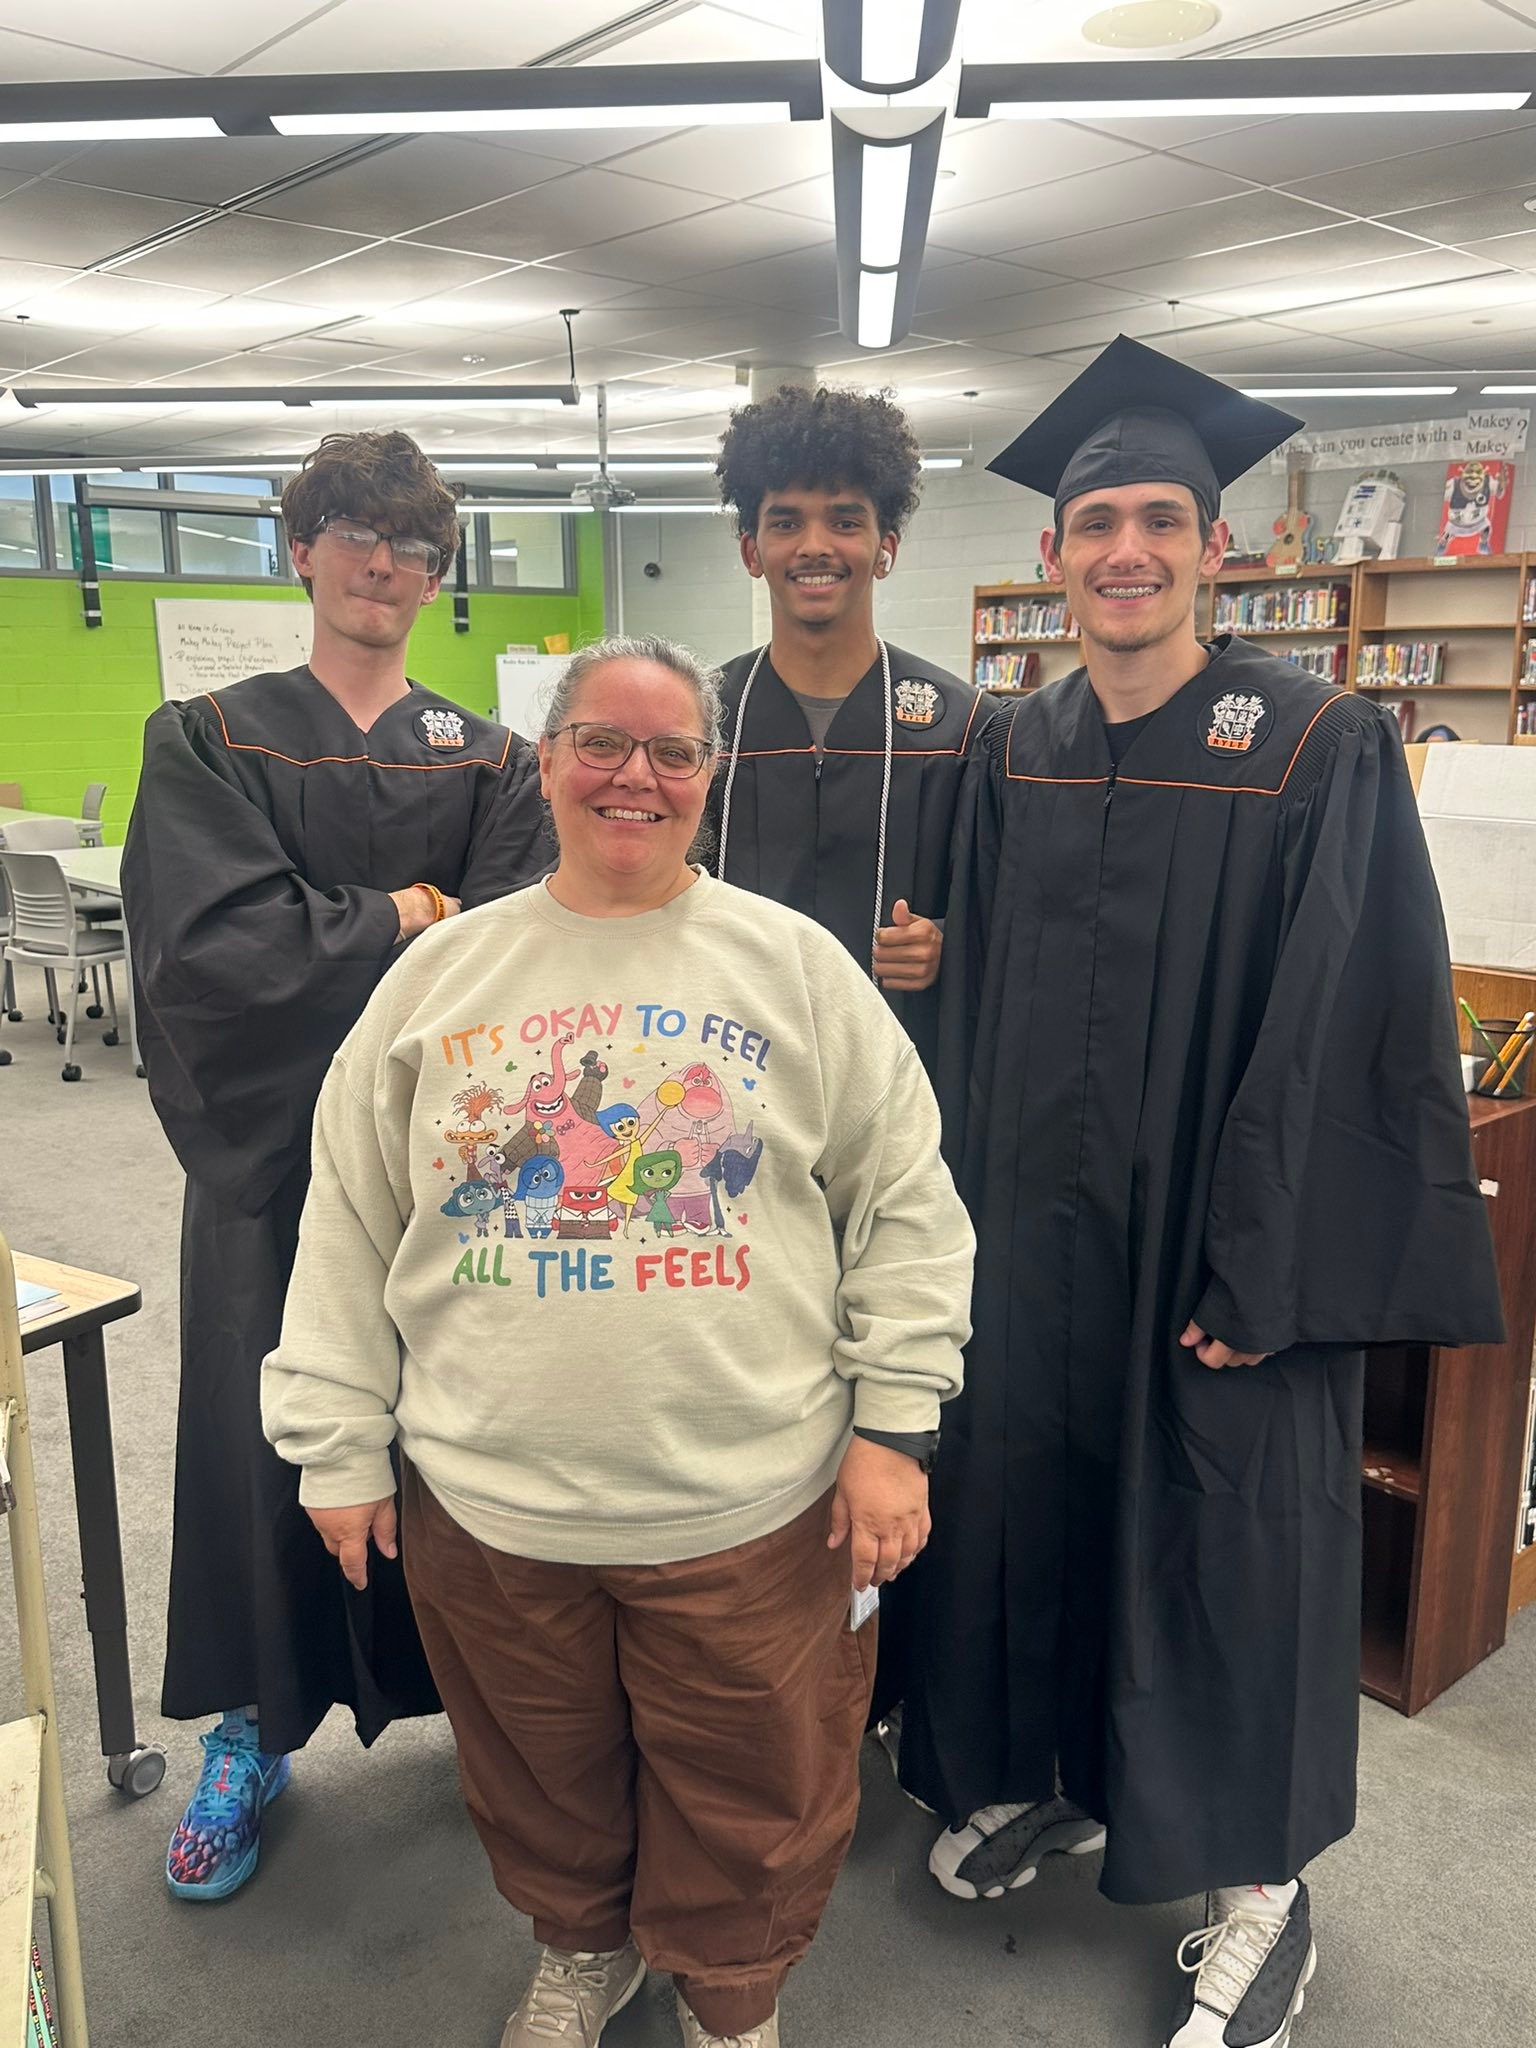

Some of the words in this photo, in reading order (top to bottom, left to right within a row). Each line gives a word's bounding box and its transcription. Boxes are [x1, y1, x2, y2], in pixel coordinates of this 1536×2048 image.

[1468, 414, 1513, 431] Makey
[1517, 419, 1528, 439] ?
[1312, 442, 1335, 454] can
[1340, 438, 1365, 455] you
[1370, 431, 1414, 448] create
[1417, 427, 1447, 443] with
[1453, 429, 1462, 441] a
[1466, 440, 1510, 456] Makey
[1213, 738, 1244, 748] RYLE
[440, 1022, 505, 1068] IT'S
[519, 1003, 623, 1044] OKAY
[636, 1004, 687, 1038] TO
[700, 1012, 772, 1072] FEEL
[452, 1243, 512, 1287] ALL
[528, 1247, 615, 1298] THE
[635, 1243, 751, 1293] FEELS
